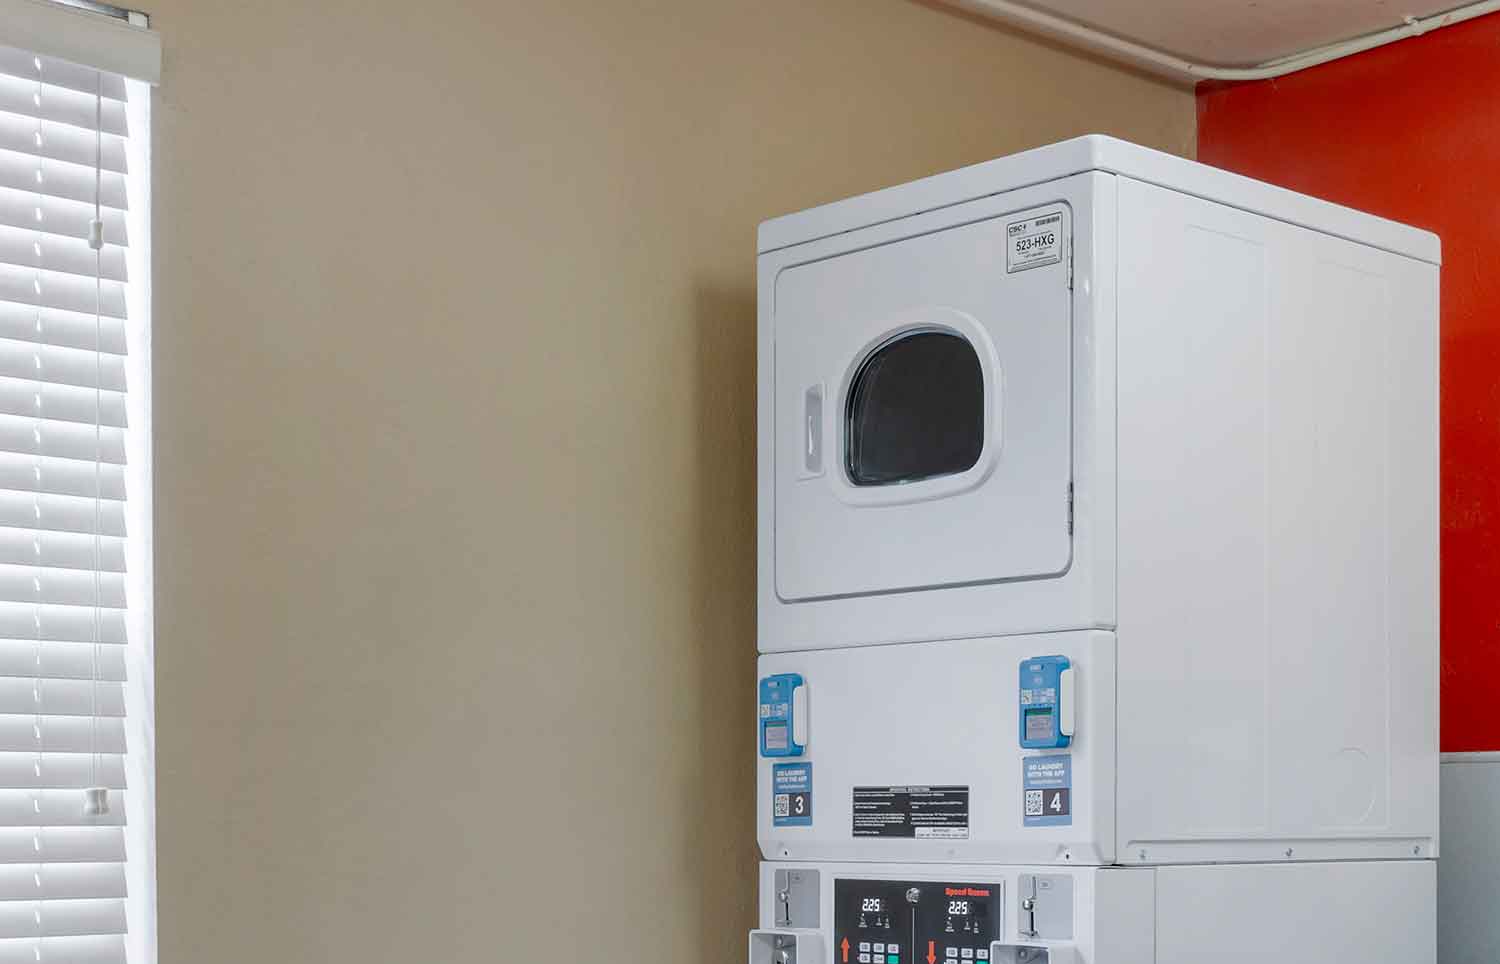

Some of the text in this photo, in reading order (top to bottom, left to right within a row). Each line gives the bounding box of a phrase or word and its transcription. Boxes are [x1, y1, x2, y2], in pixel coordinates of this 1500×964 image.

[1016, 233, 1055, 252] 523-HXG
[795, 795, 804, 814] 3
[1049, 791, 1062, 812] 4
